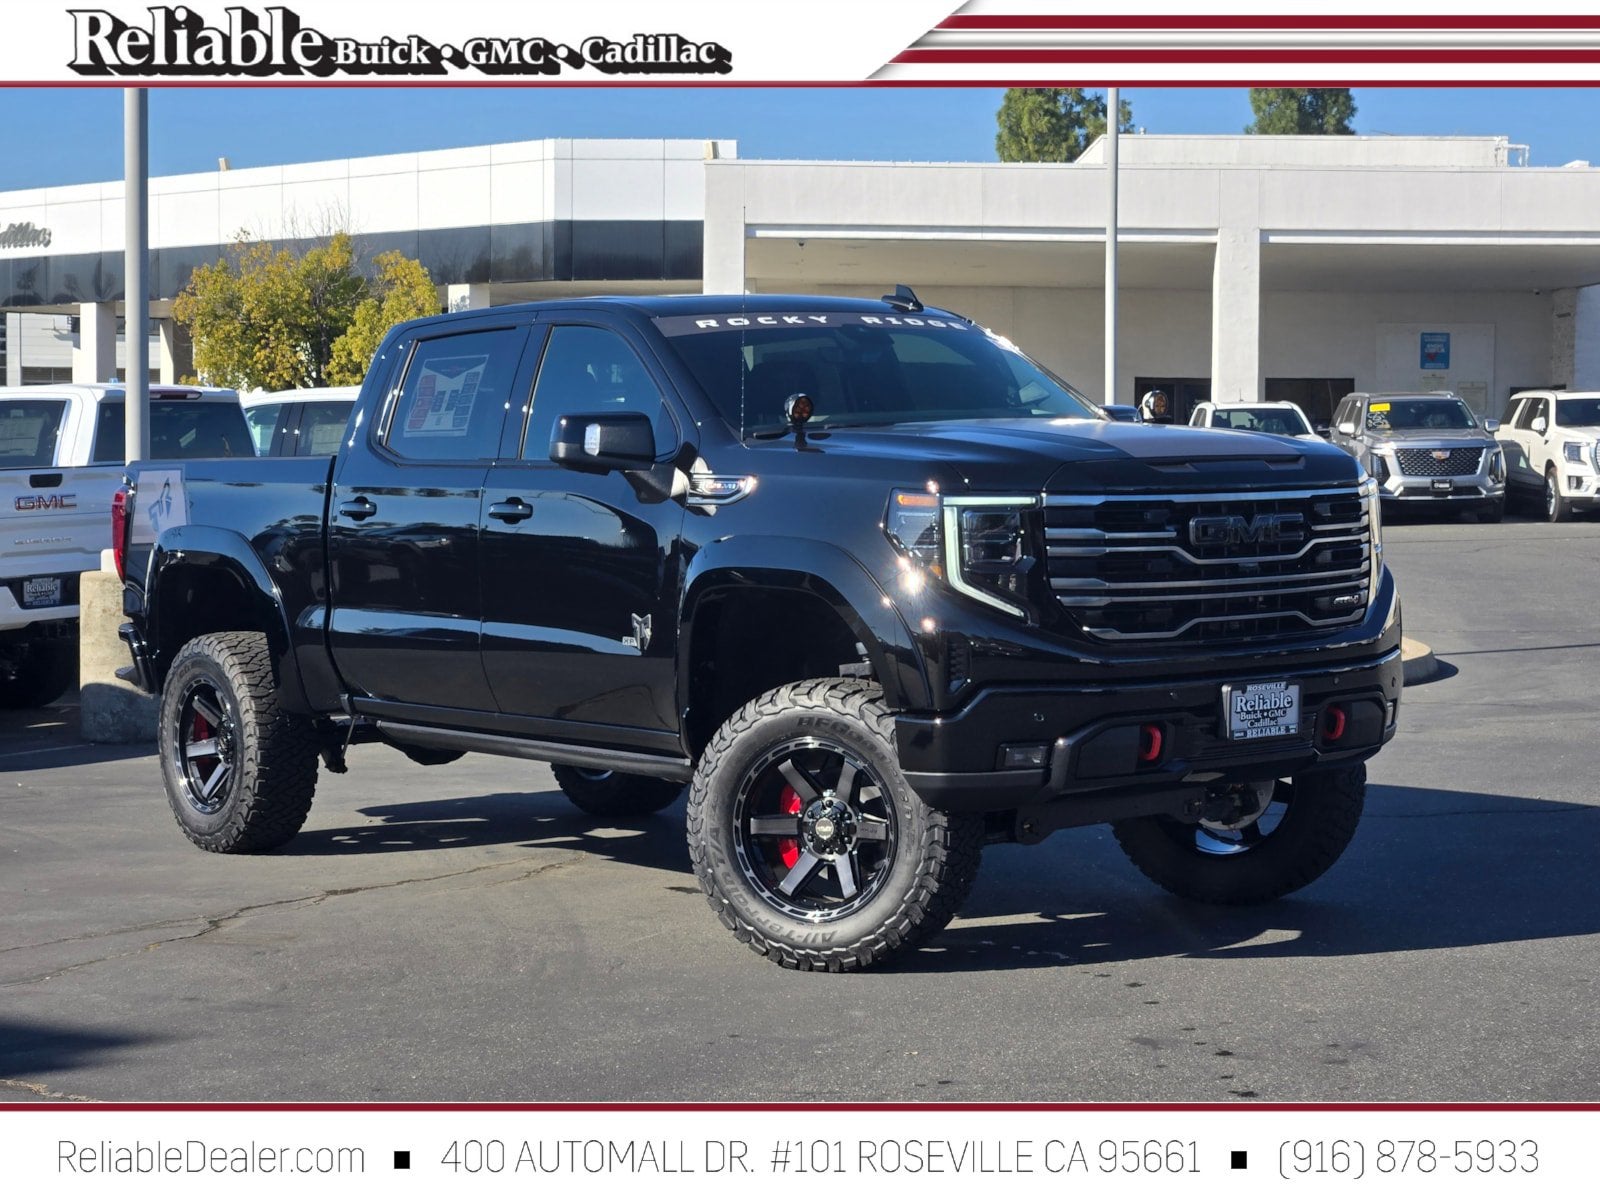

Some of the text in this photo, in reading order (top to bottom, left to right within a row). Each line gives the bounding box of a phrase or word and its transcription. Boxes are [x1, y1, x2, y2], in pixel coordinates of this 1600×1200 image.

[695, 315, 970, 331] ROCKY RIDGE
[14, 494, 78, 512] GMC
[1188, 512, 1304, 546] GMC
[1246, 682, 1286, 691] ROSEVILLE
[1235, 691, 1293, 713] Reliable
[1240, 708, 1287, 721] Buick GMC
[1247, 718, 1278, 728] Cadillac
[1246, 726, 1286, 738] RELIABLE
